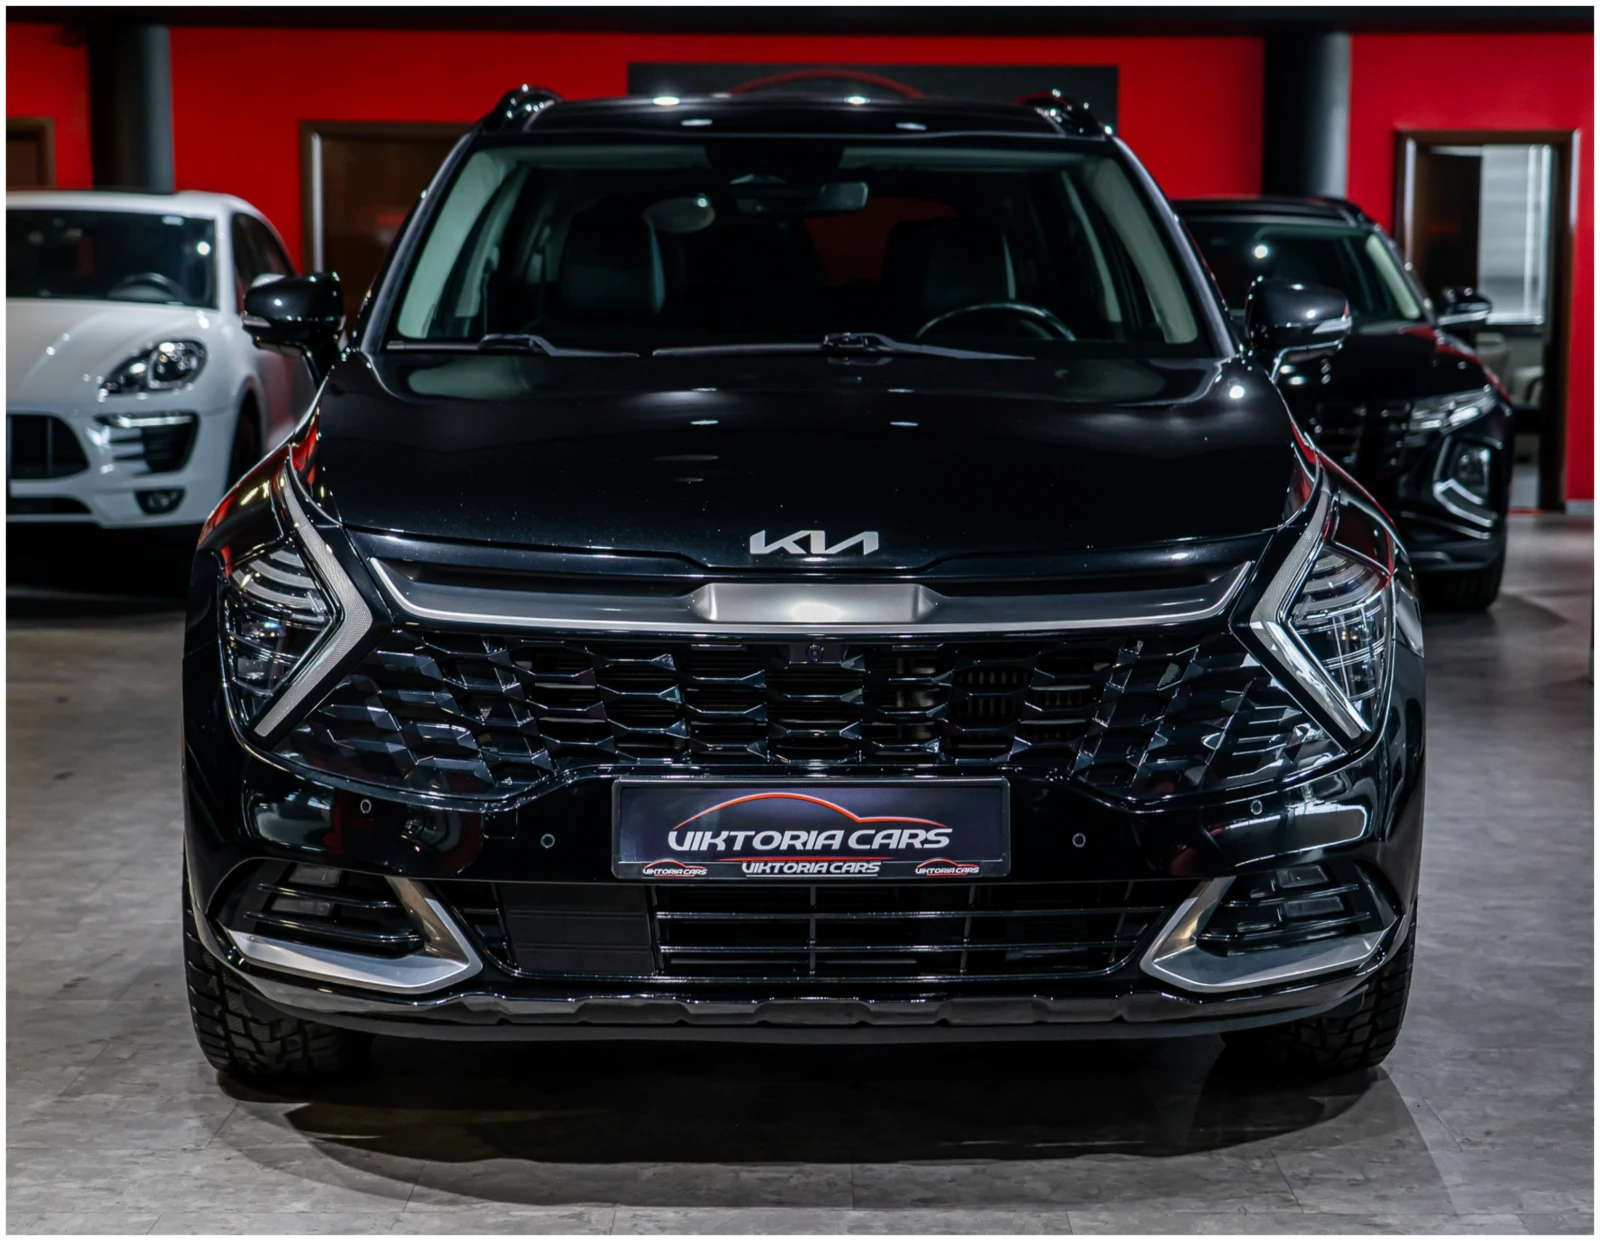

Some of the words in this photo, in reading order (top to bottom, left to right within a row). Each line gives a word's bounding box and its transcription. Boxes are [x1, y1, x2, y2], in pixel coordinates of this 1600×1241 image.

[750, 529, 879, 555] KIA
[668, 830, 844, 851] VIKTORIA
[848, 828, 953, 849] CARS
[741, 862, 828, 874] VIKTORIA
[829, 862, 881, 873] CARS
[915, 867, 955, 875] VIKTORIA
[955, 866, 980, 874] CARS
